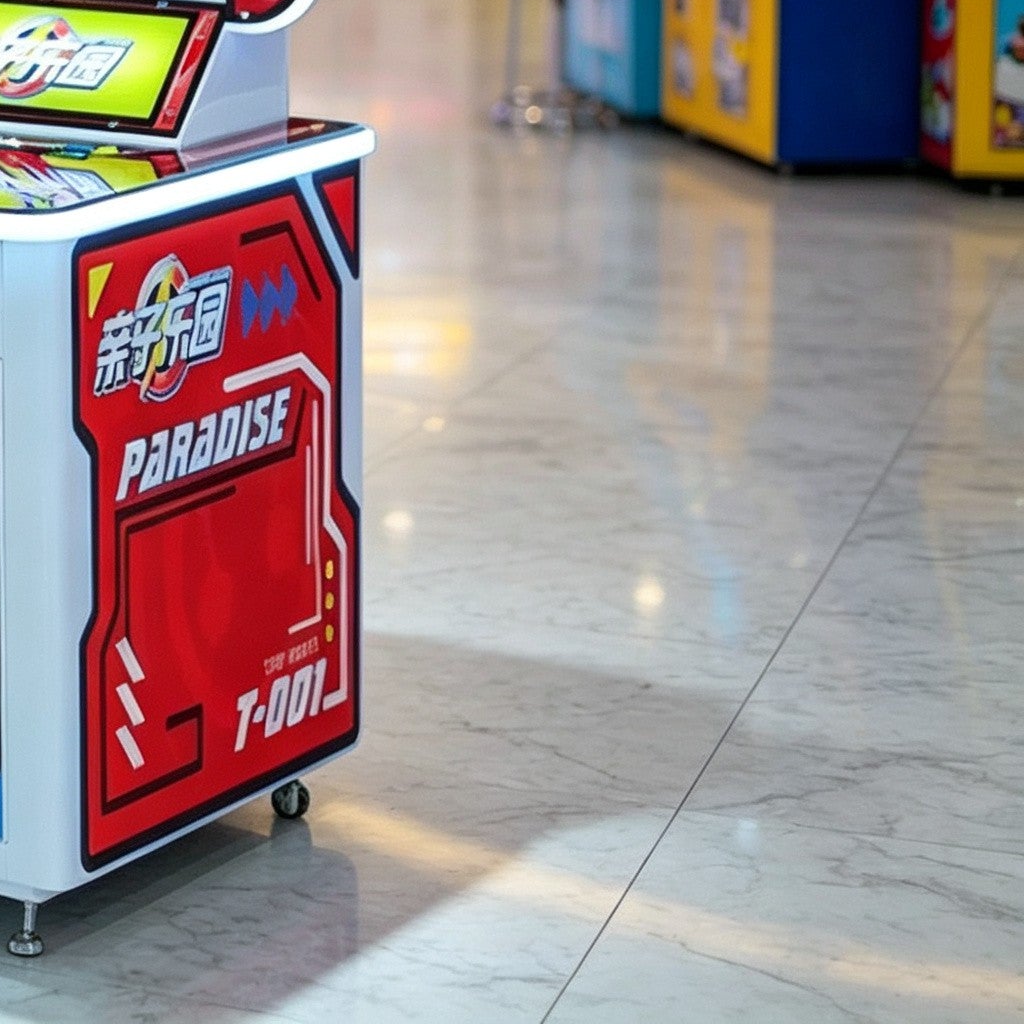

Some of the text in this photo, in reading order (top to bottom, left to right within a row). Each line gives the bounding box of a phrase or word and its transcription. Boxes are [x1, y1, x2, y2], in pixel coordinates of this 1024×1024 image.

[93, 266, 233, 397] 亲子乐园
[234, 657, 327, 753] T-001
